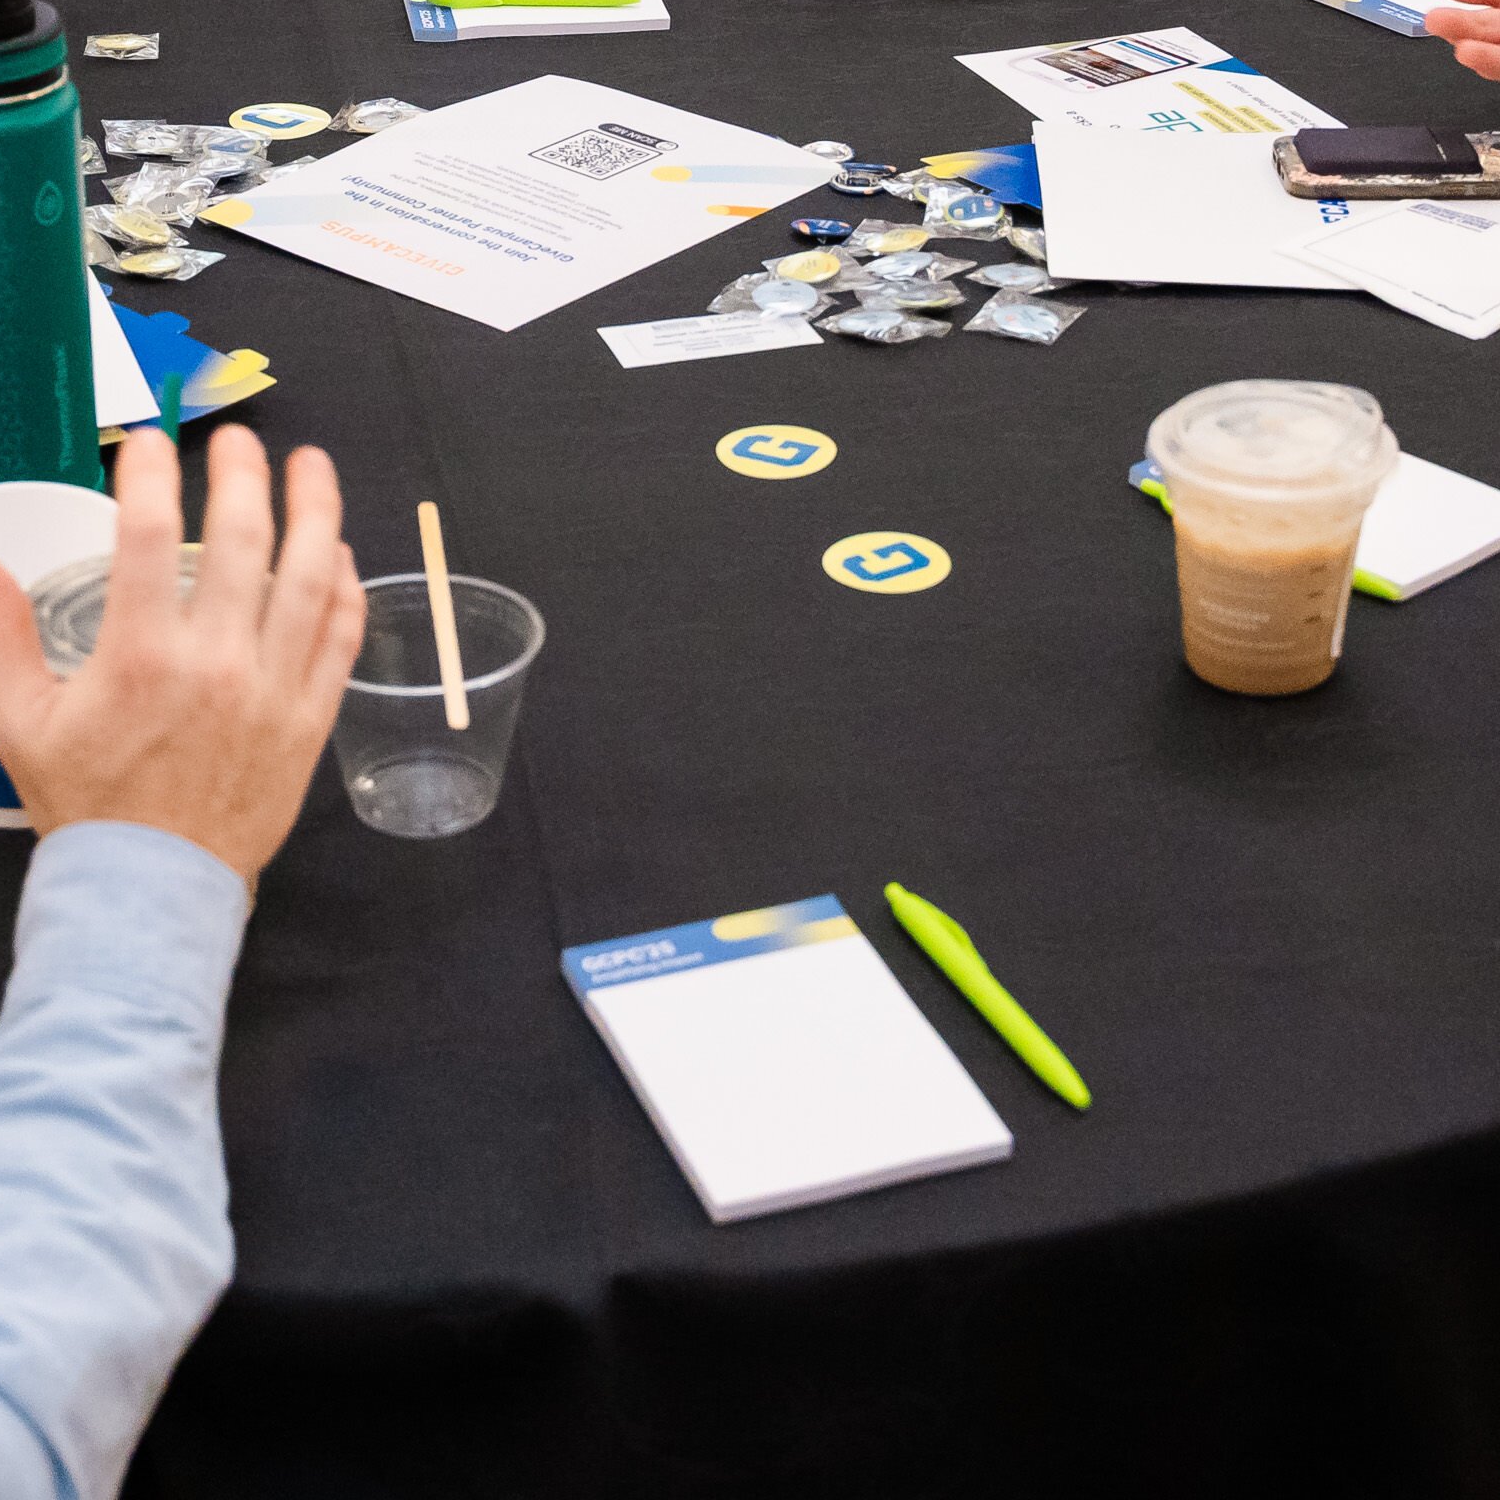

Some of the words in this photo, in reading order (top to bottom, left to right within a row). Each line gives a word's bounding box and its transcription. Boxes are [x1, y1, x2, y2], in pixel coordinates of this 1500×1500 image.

[341, 175, 427, 209] Community!
[344, 191, 369, 202] the
[369, 199, 385, 209] in
[385, 205, 477, 240] conversation
[427, 207, 482, 229] Partner
[320, 220, 465, 276] GIVECAMPUS
[477, 239, 503, 250] the
[483, 226, 574, 262] GiveCampus
[504, 248, 538, 262] Join
[733, 435, 817, 467] G
[843, 542, 930, 581] G
